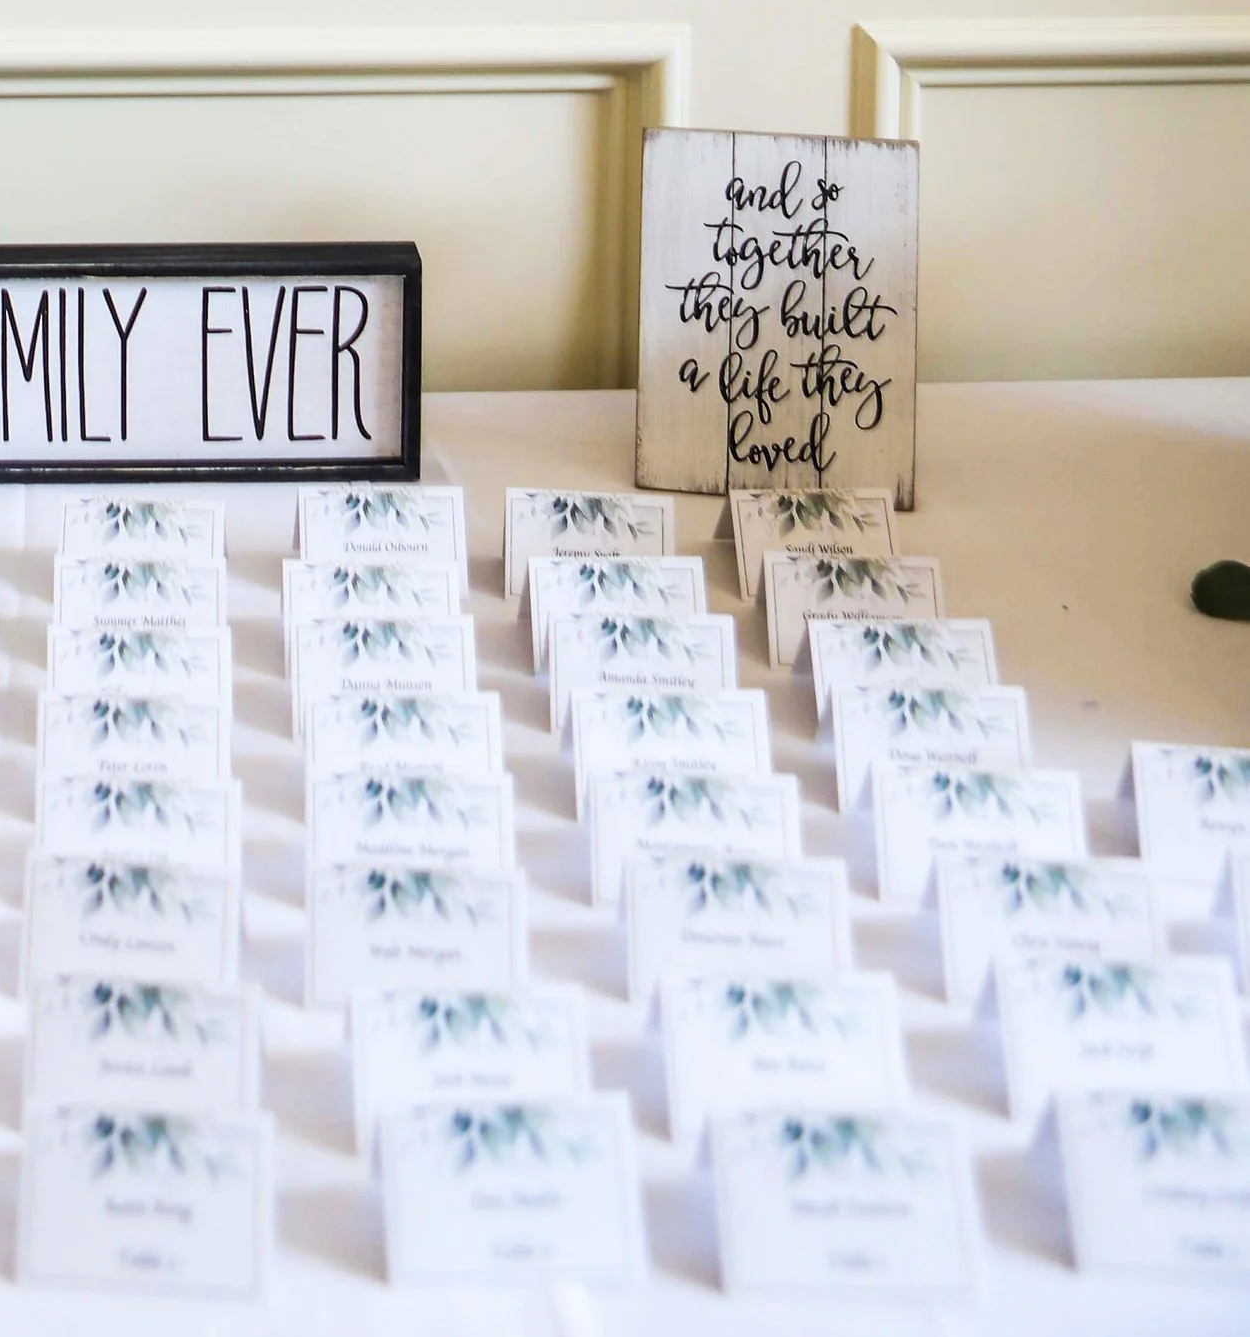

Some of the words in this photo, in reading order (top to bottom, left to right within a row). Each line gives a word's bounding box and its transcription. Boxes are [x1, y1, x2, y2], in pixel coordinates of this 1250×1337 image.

[725, 161, 803, 219] and
[811, 175, 844, 210] so
[703, 217, 875, 290] together
[665, 272, 770, 350] they
[780, 279, 898, 341] built
[202, 285, 372, 442] EVER
[679, 358, 711, 393] a
[718, 349, 791, 425] life
[790, 344, 892, 430] they
[729, 410, 837, 473] loved
[343, 539, 383, 552] Donald
[818, 542, 854, 555] Wilson
[599, 669, 648, 685] Amanda
